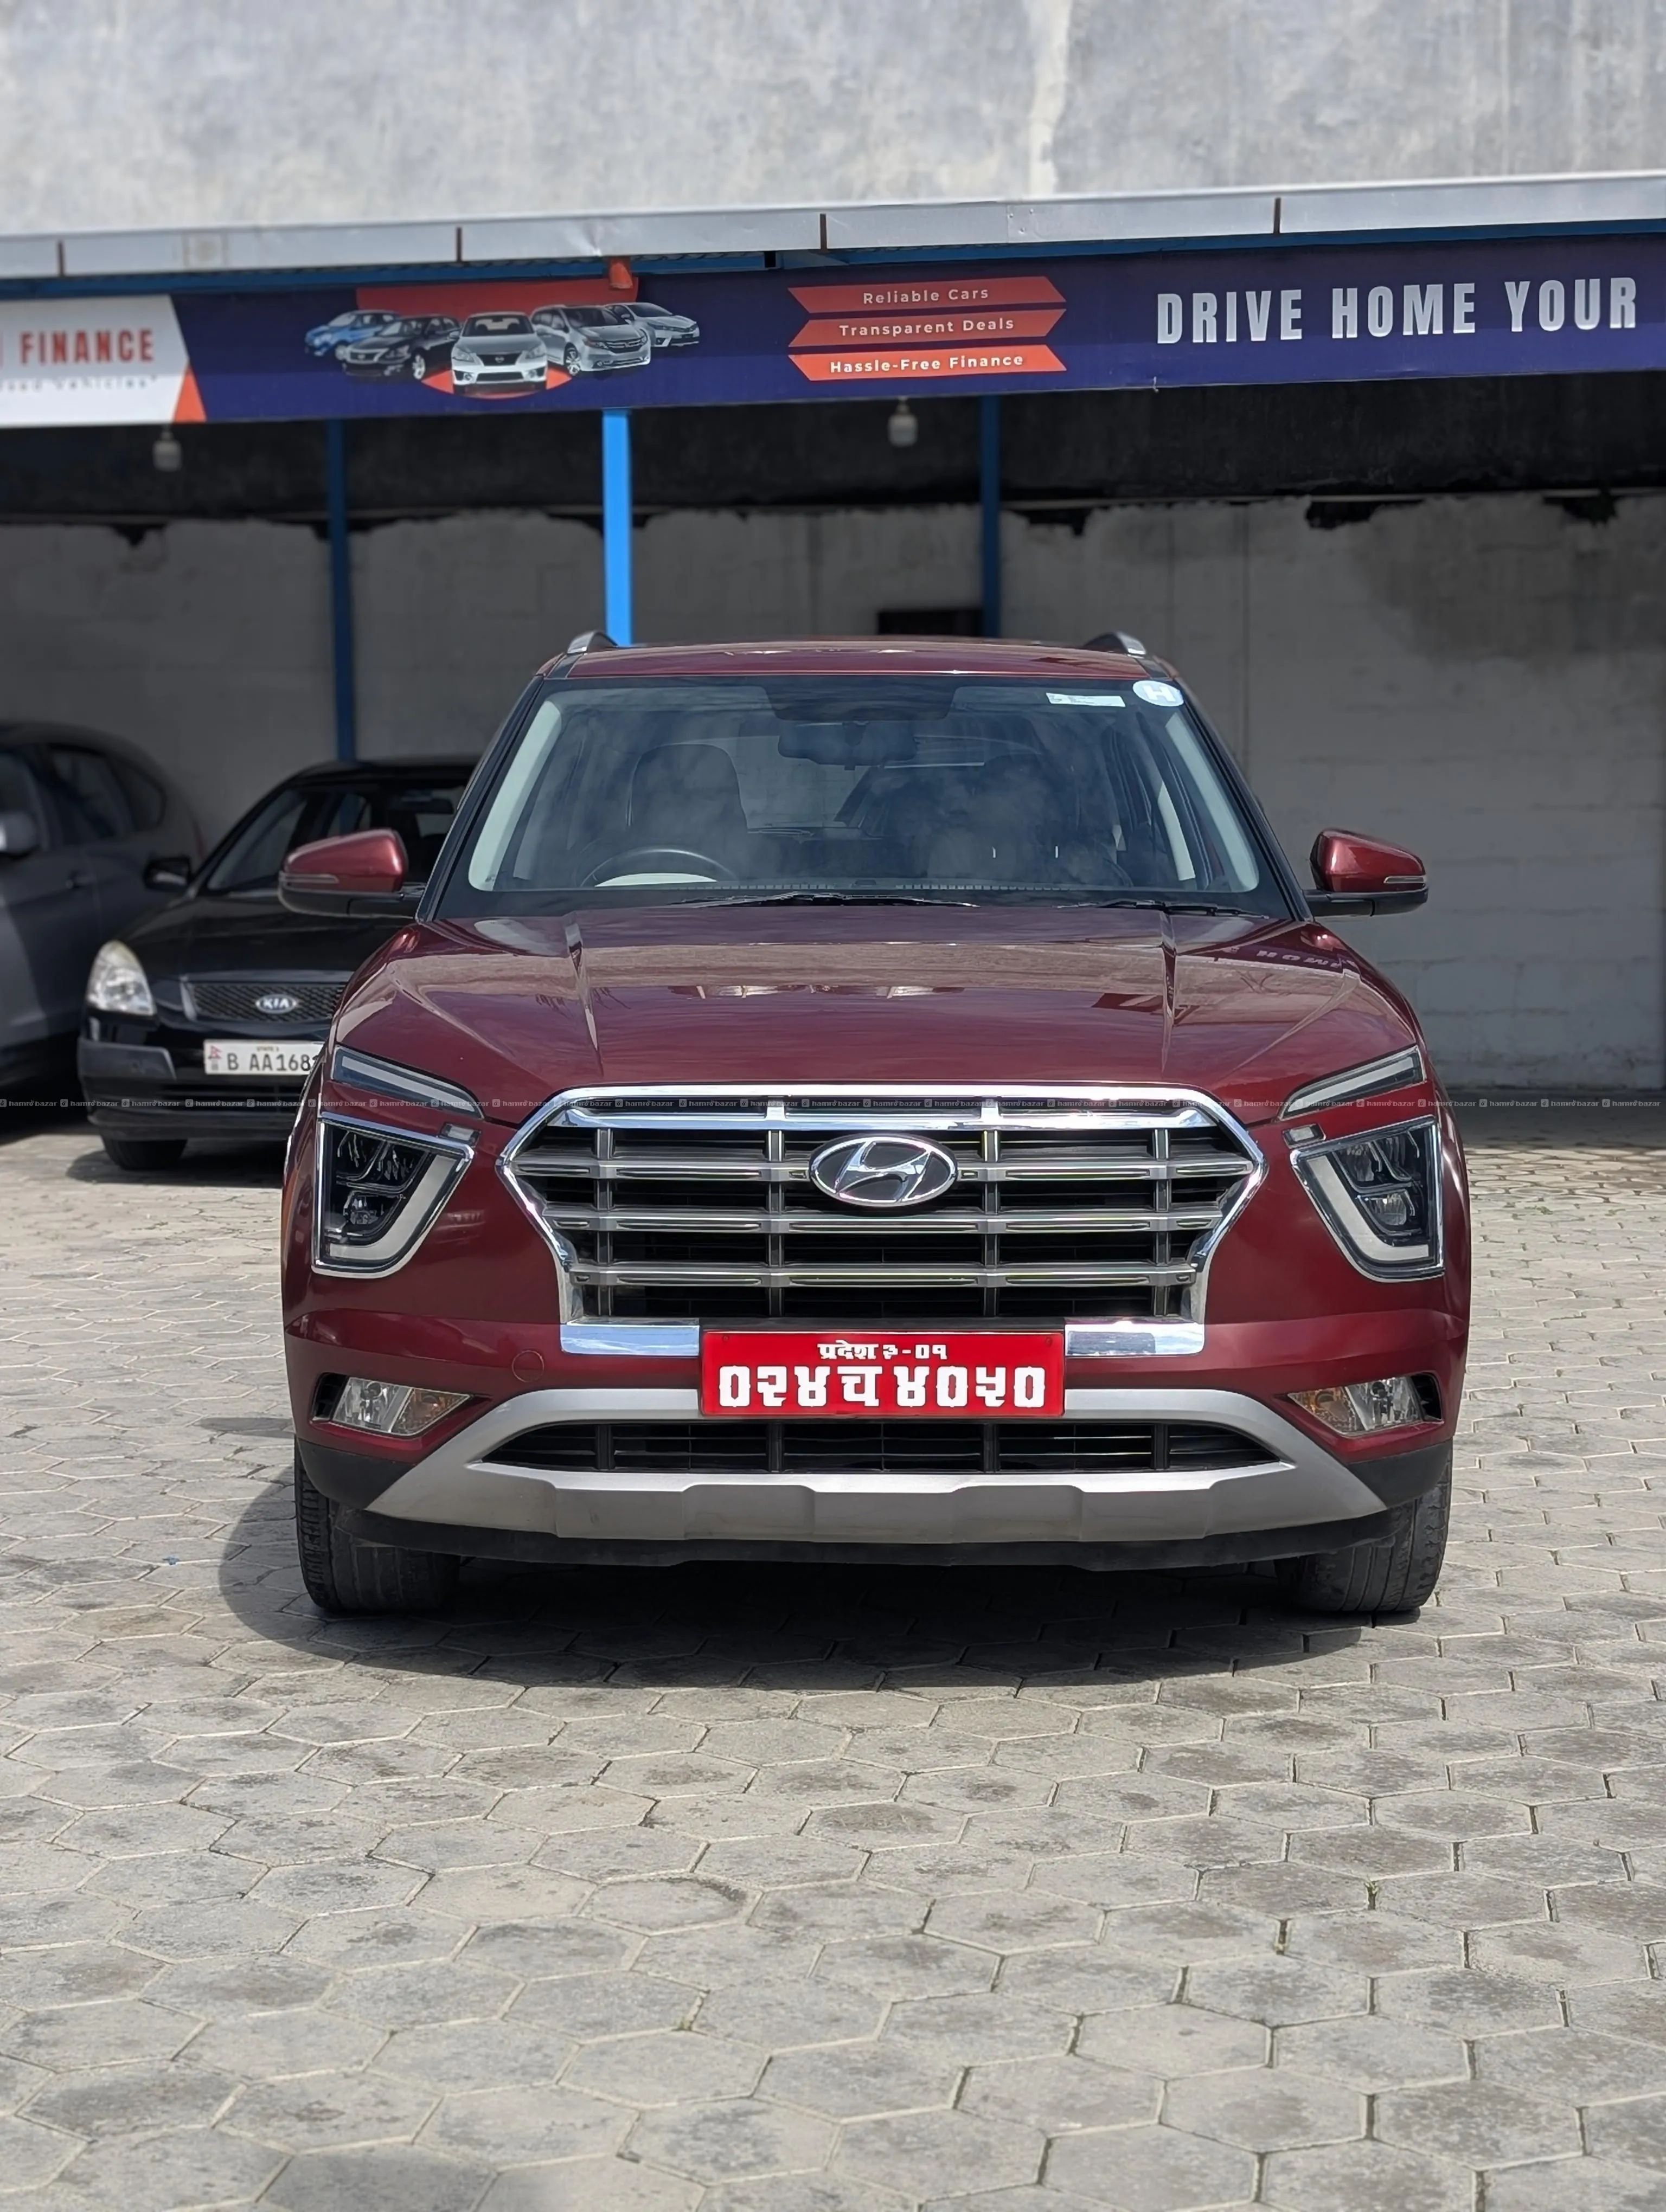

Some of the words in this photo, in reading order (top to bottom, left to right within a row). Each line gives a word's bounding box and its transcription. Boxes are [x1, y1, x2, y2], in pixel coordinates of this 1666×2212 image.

[863, 290, 939, 304] Reliable
[949, 287, 989, 300] Cars
[1157, 289, 1302, 344] DRIVE
[1332, 282, 1475, 338] HOME
[1504, 277, 1637, 332] YOUR
[840, 321, 954, 337] Transparent
[963, 318, 1014, 331] Deals
[20, 328, 155, 366] FINANCE
[830, 357, 940, 373] Hassle-Free
[950, 354, 1023, 369] Finance
[1143, 685, 1176, 702] H
[262, 998, 290, 1009] KIA
[227, 1053, 239, 1071] B
[249, 1053, 319, 1072] AA168
[817, 1340, 879, 1360] प्रदेश
